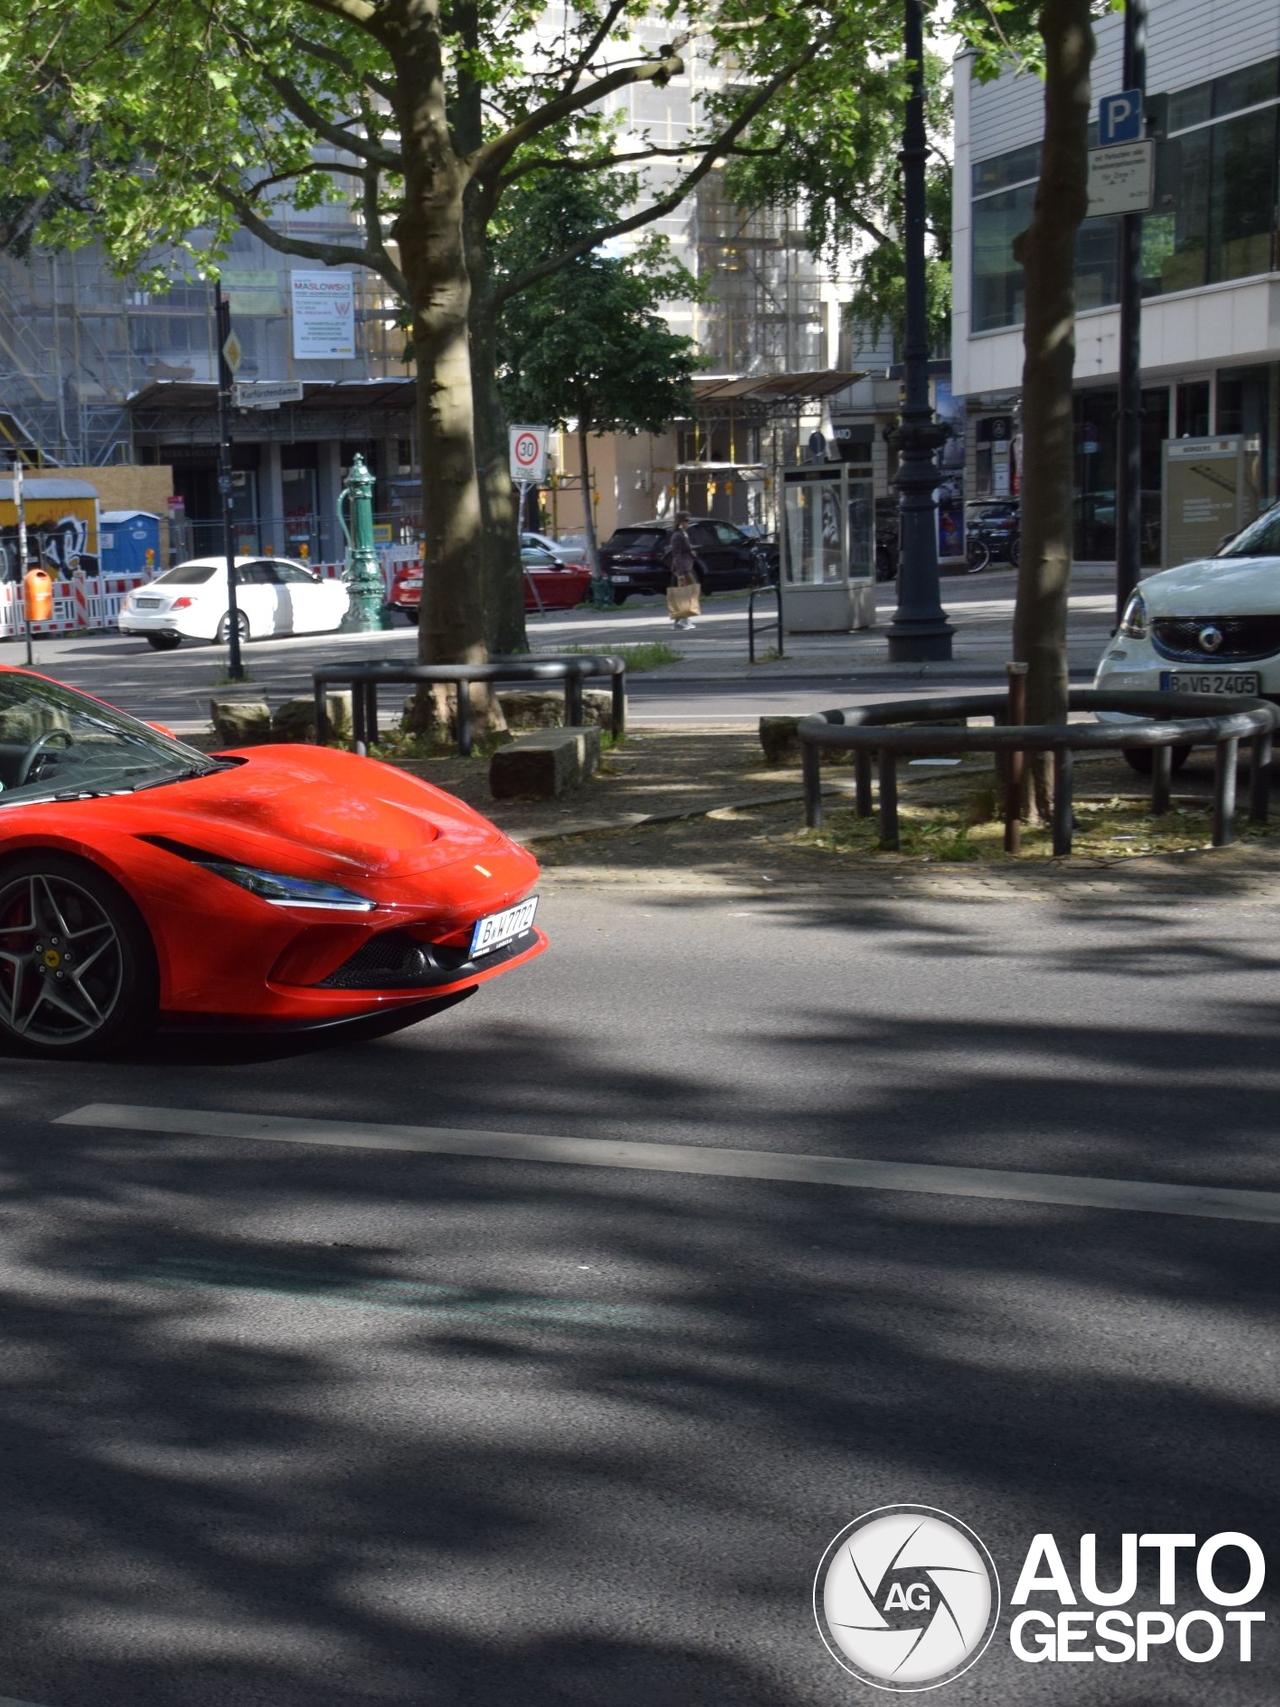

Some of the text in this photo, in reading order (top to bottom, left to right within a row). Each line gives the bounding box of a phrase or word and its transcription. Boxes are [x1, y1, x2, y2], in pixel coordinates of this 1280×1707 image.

[1108, 98, 1132, 138] P
[293, 282, 351, 291] MASLOWSKI
[241, 387, 298, 399] Kurfürstendamm
[520, 442, 534, 457] 30
[516, 467, 535, 477] ZONE
[1170, 676, 1255, 694] B VG 2405
